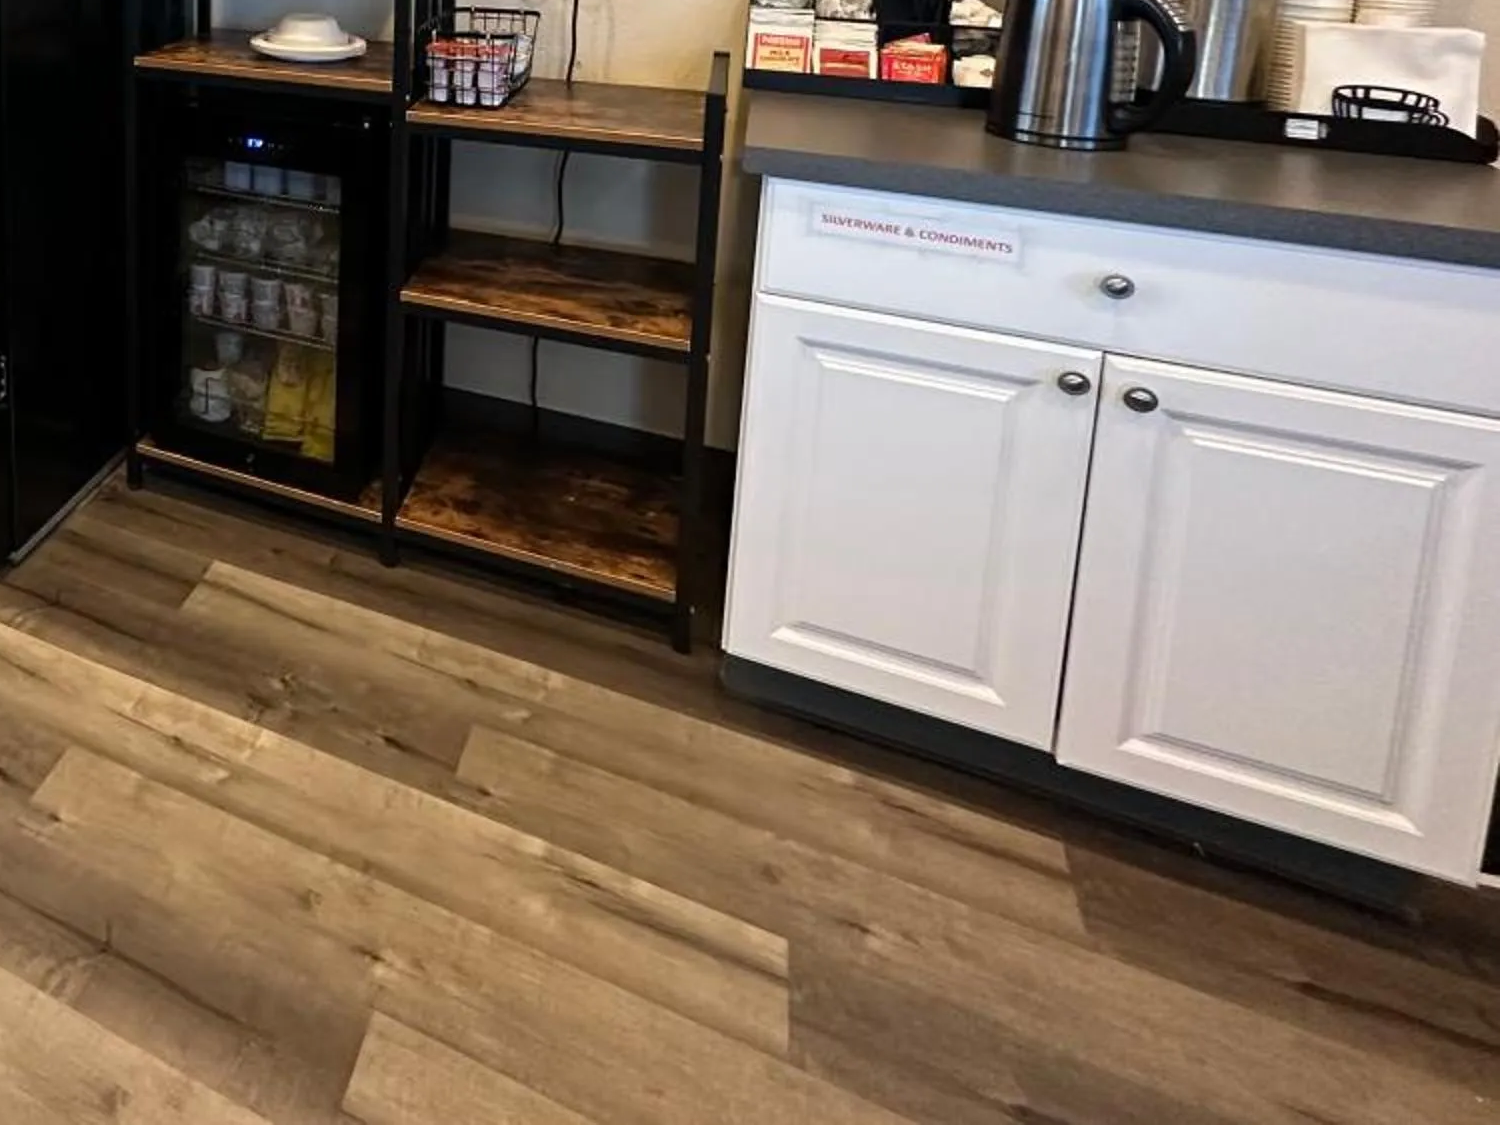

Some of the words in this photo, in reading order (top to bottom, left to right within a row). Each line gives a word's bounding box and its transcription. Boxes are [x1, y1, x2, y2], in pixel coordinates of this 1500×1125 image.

[821, 213, 901, 236] SILVERWARE
[904, 226, 915, 238] &
[919, 229, 1013, 254] CONDIMENTS
